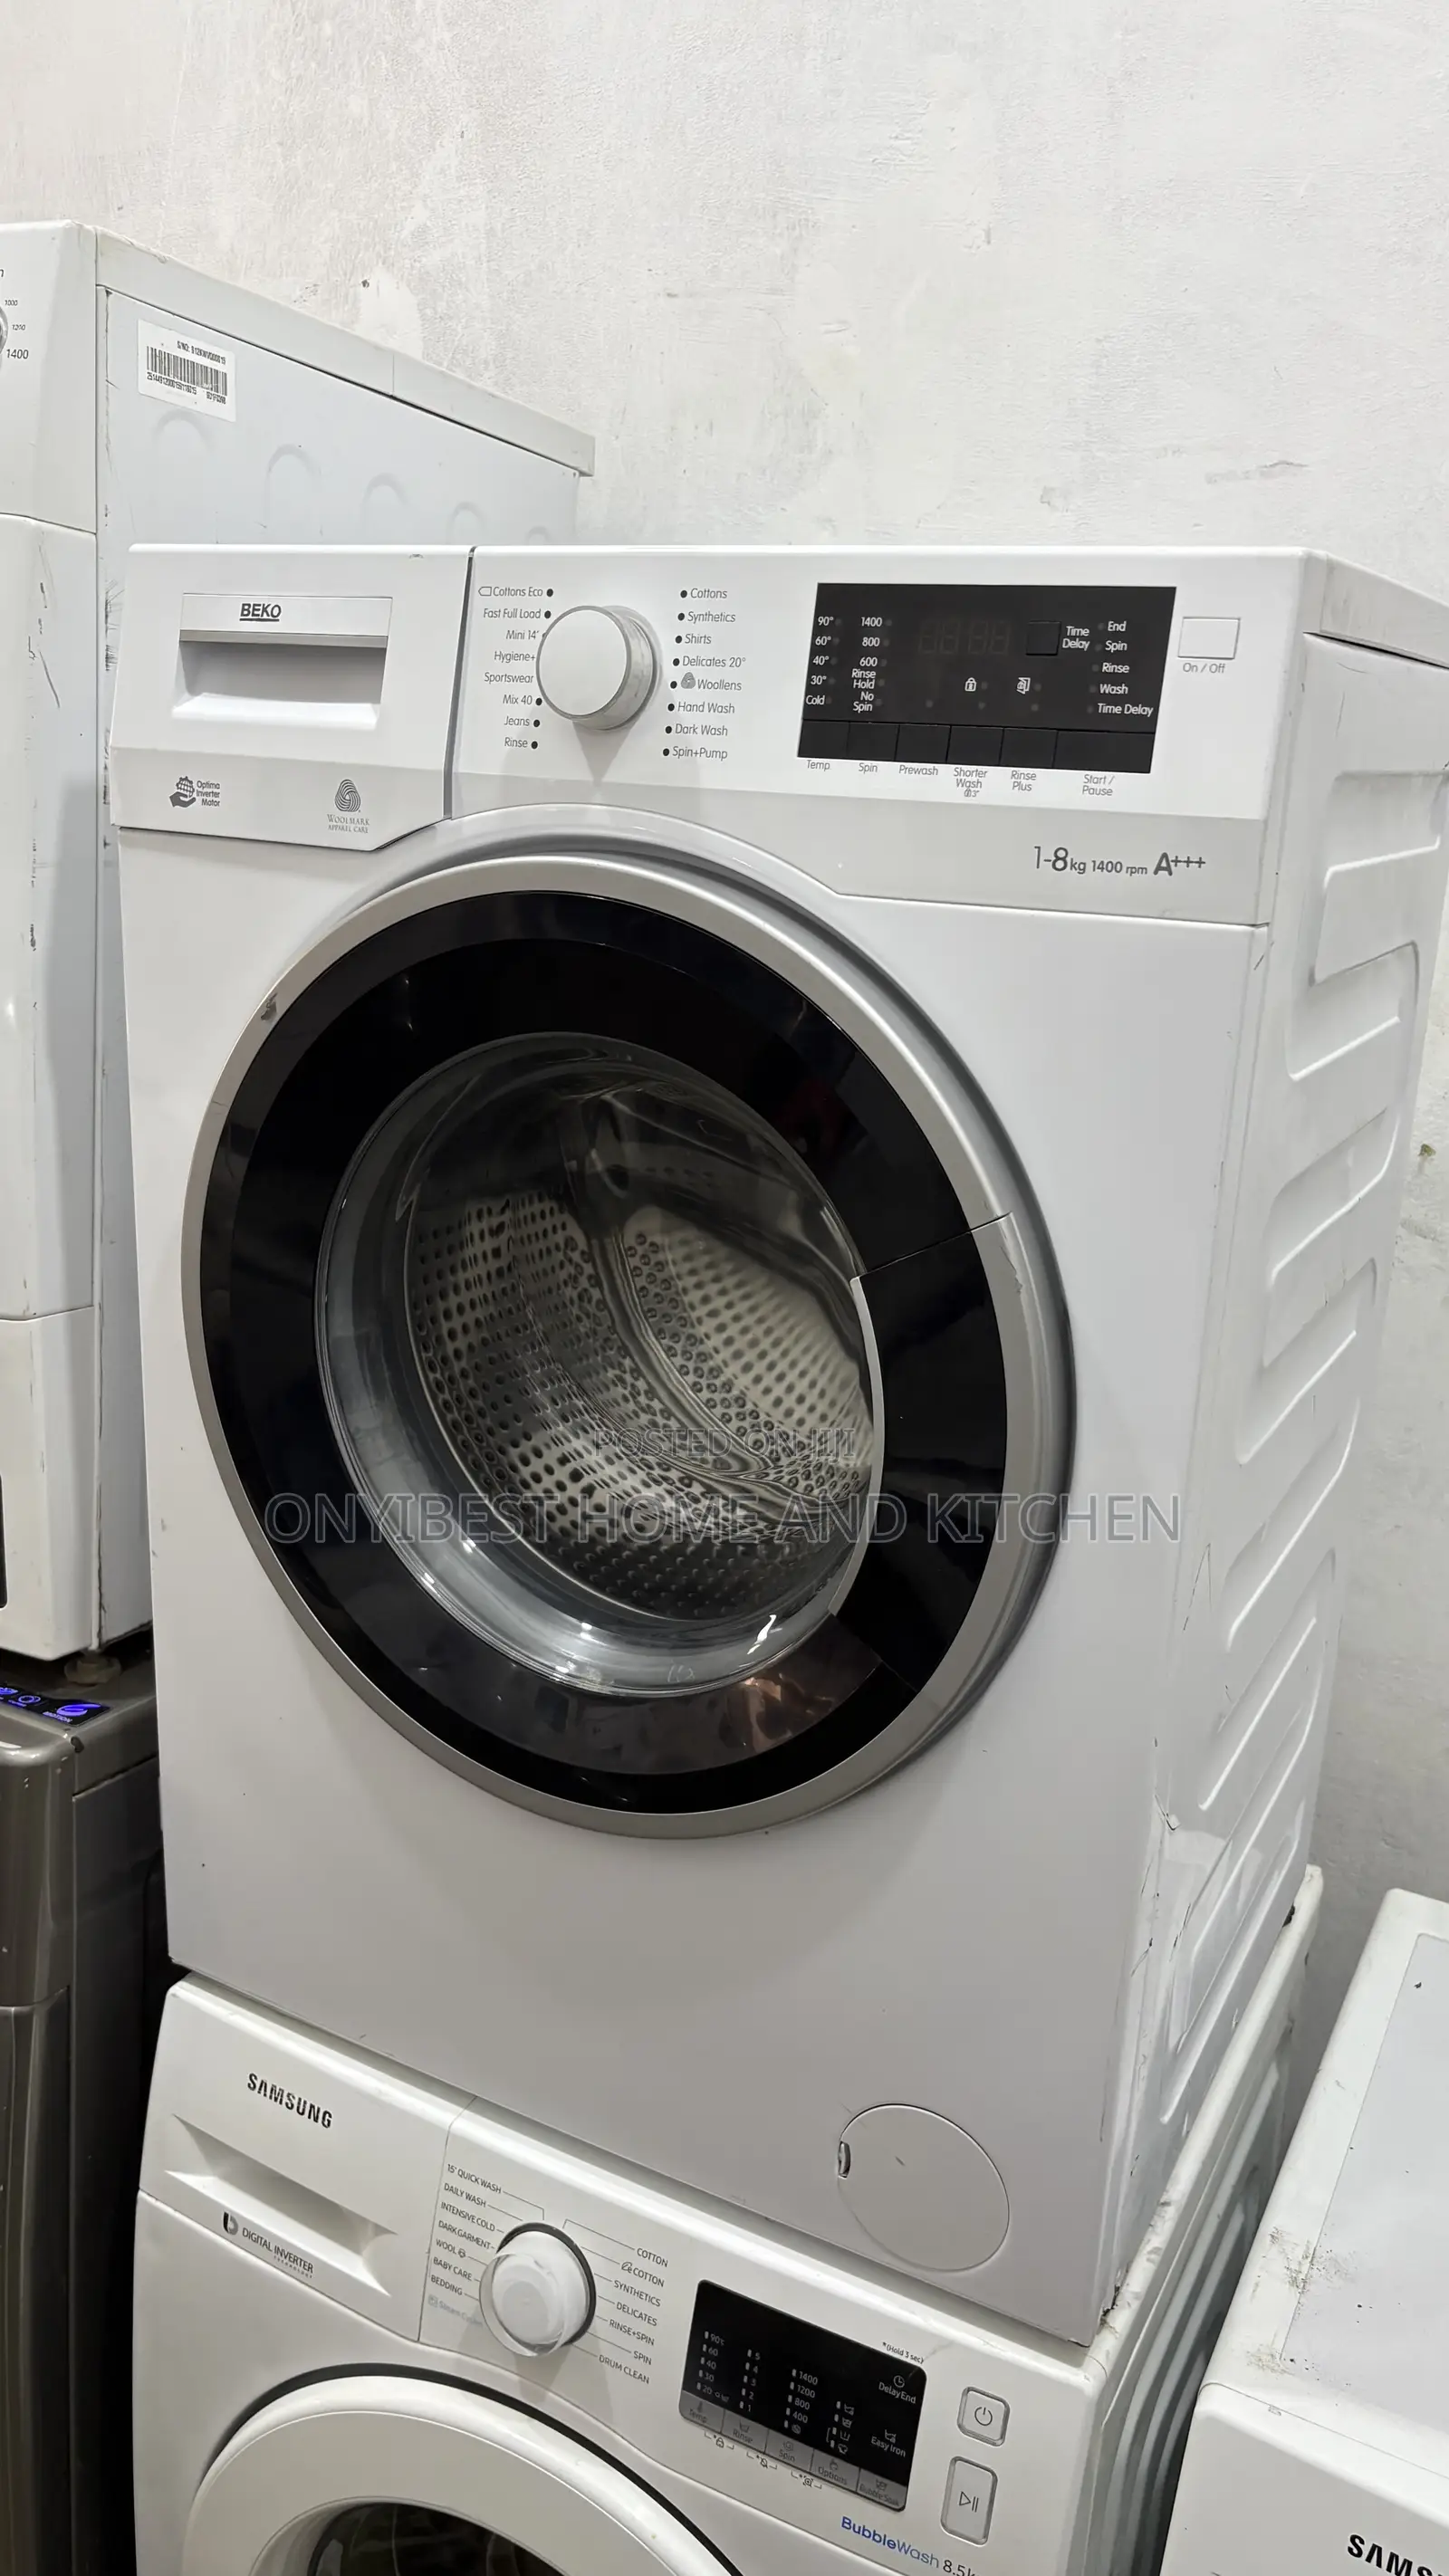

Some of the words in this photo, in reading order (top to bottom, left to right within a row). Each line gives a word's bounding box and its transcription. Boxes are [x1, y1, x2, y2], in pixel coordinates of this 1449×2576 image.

[6, 349, 29, 359] 1400
[493, 587, 526, 598] Cottons
[527, 587, 543, 598] Eco
[690, 588, 727, 599] Cottons
[240, 603, 282, 619] BEKO
[483, 608, 502, 618] Fast
[503, 608, 517, 619] Full
[518, 608, 541, 619] Load
[687, 610, 736, 624] Synthetics
[818, 616, 834, 627] 90°
[861, 617, 882, 627] 1400
[1108, 621, 1127, 632] End
[505, 628, 525, 640] Mini
[1066, 626, 1089, 637] Time
[685, 634, 712, 645] Shirts
[815, 636, 831, 646] 60°
[862, 637, 879, 647] 800
[1062, 638, 1090, 651] Delay
[1105, 640, 1128, 653] Spin
[494, 650, 536, 664] Hygiene+
[682, 656, 726, 668] Delicates
[728, 656, 746, 668] 20°
[812, 656, 830, 666] 40°
[859, 656, 878, 666] 600
[851, 668, 876, 679] Rinse
[1101, 662, 1129, 674] Rinse
[1182, 663, 1198, 673] On
[1208, 663, 1225, 674] Off
[485, 672, 534, 685] Sportswear
[811, 675, 827, 685] 30°
[853, 679, 875, 689] Hold
[697, 680, 742, 692] Woollens
[1099, 684, 1128, 694] Wash
[503, 694, 520, 706] Mix
[521, 694, 533, 706] 40
[805, 694, 825, 705] Cold
[860, 691, 874, 701] No
[678, 702, 705, 713] Hand
[706, 703, 735, 714] Wash
[853, 701, 873, 713] Spin
[1098, 704, 1122, 714] Time
[1124, 704, 1153, 717] Delay
[504, 716, 530, 727] Jeans
[675, 724, 698, 736] Dark
[700, 725, 728, 737] Wash
[504, 738, 528, 749] Rinse
[672, 746, 728, 761] Spin+Pump
[859, 762, 878, 774] Spin
[898, 764, 939, 776] Prewash
[954, 767, 988, 778] Shorter
[1011, 770, 1037, 781] Rinse
[1083, 773, 1107, 785] Start
[197, 780, 220, 790] Optima
[956, 779, 983, 789] Wash
[1012, 780, 1032, 792] Plus
[196, 790, 220, 799] Inverter
[1082, 785, 1113, 797] Pause
[201, 798, 220, 808] Motor
[327, 813, 370, 826] WOOLMARK
[327, 823, 352, 832] APPAREL
[354, 825, 369, 834] CARE
[1091, 860, 1123, 874] 1400
[1126, 866, 1147, 876] rpm
[1153, 852, 1206, 876] A+++
[247, 2073, 333, 2129] SAMSUNG
[457, 2169, 480, 2185] QUICK
[480, 2178, 502, 2194] WASH
[444, 2183, 465, 2198] DAILY
[465, 2191, 486, 2207] WASH
[441, 2201, 476, 2224] INTENSIVE
[476, 2217, 495, 2232] COLD
[438, 2220, 457, 2236] DARK
[457, 2228, 490, 2250] GARMENT
[242, 2226, 273, 2253] DIGITAL
[274, 2246, 314, 2274] INVERTER
[436, 2238, 457, 2255] WOOL
[637, 2247, 668, 2267] COTTON
[433, 2256, 452, 2272] BABY
[453, 2266, 472, 2281] CARE
[633, 2267, 665, 2287] COTTON
[431, 2274, 463, 2295] BEDDING
[614, 2280, 661, 2307] SYNTHETICS
[616, 2302, 657, 2327] DELICATES
[609, 2319, 655, 2346] RINSE+SPIN
[708, 2347, 719, 2357] 60
[755, 2352, 761, 2361] 5
[905, 2351, 909, 2359] 3
[633, 2351, 652, 2366] SPIN
[599, 2354, 623, 2372] DRUM
[623, 2366, 650, 2385] CLEAN
[706, 2360, 716, 2370] 40
[753, 2365, 758, 2374] 4
[705, 2371, 715, 2382] 30
[798, 2371, 819, 2386] 1400
[751, 2379, 756, 2387] 3
[702, 2384, 713, 2395] 20
[748, 2391, 754, 2399] 2
[796, 2384, 816, 2399] 1200
[794, 2397, 811, 2410] 800
[792, 2410, 809, 2424] 400
[733, 2428, 753, 2445] Rinse
[870, 2436, 891, 2453] Easy
[890, 2444, 907, 2457] Iron
[778, 2448, 796, 2464] Spin
[818, 2466, 848, 2486] Options
[840, 2515, 940, 2569] BubbleWash
[1347, 2533, 1443, 2576] SAM
